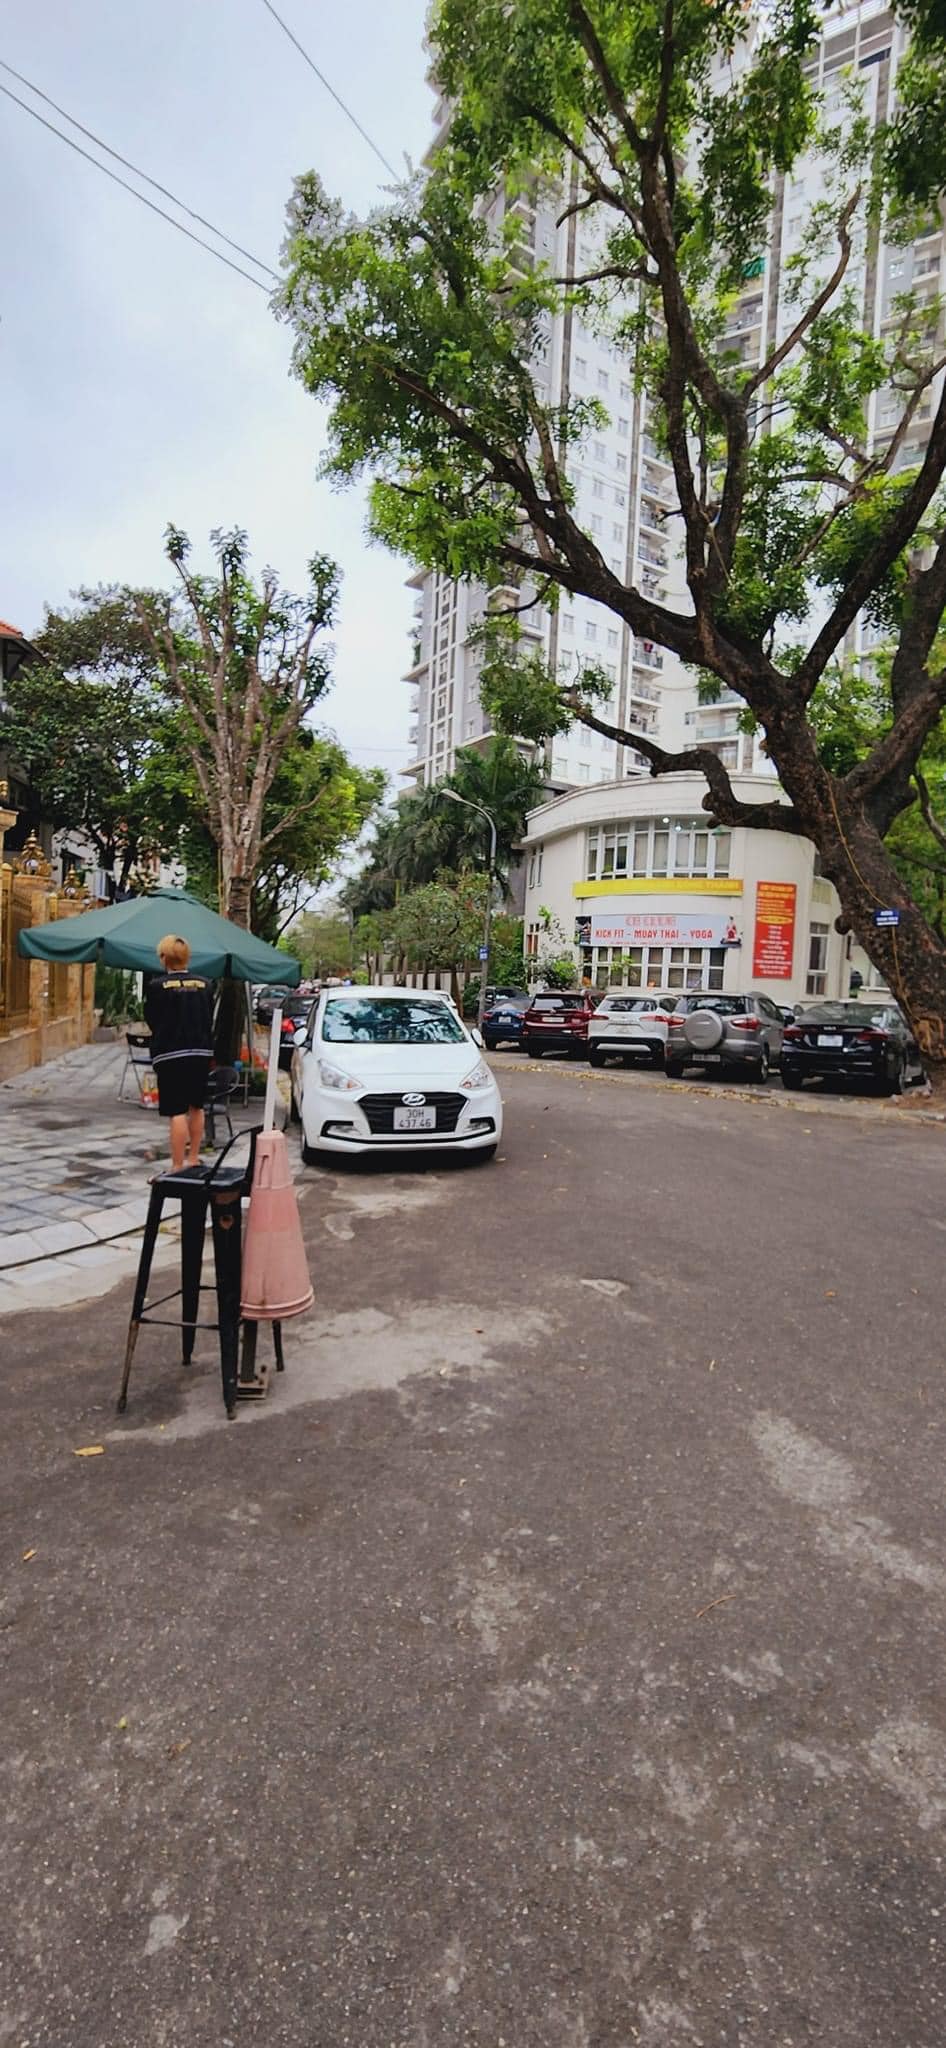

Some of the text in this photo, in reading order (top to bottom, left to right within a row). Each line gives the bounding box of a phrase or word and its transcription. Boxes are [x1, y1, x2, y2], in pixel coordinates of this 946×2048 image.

[595, 928, 713, 939] KICK FIT MUAY THAI YOGA
